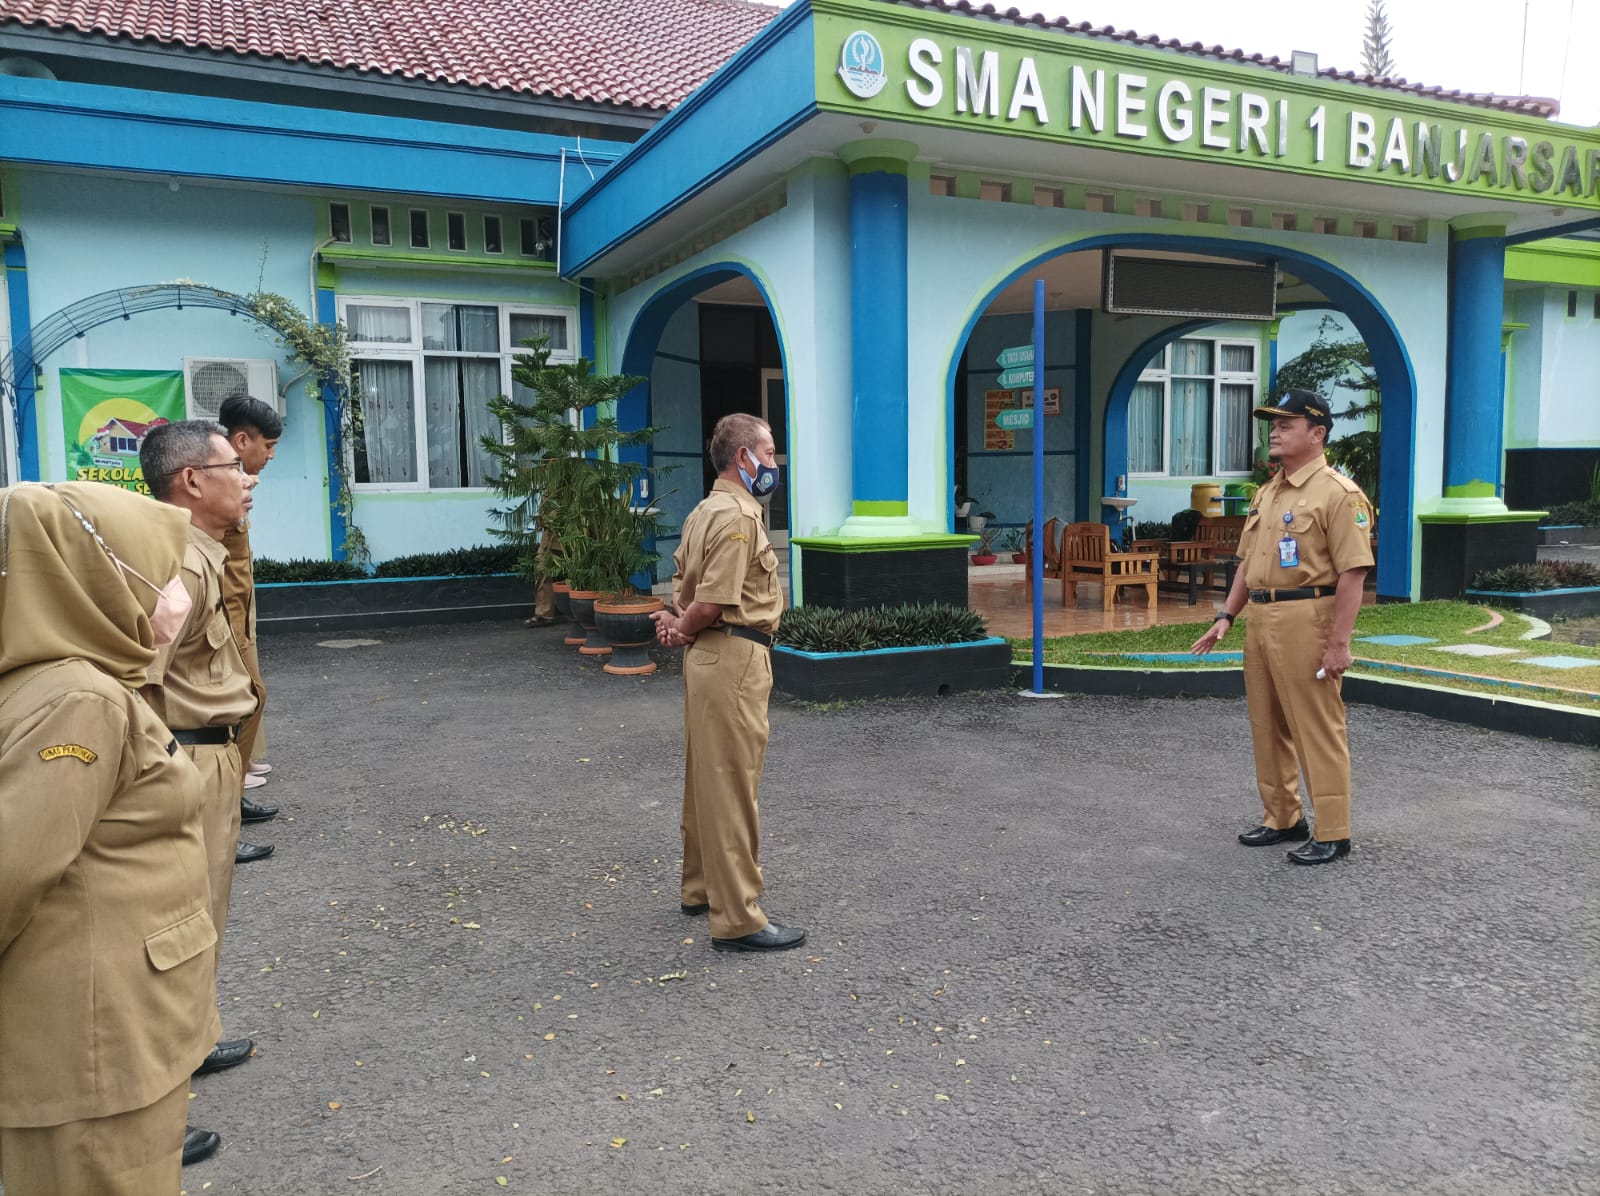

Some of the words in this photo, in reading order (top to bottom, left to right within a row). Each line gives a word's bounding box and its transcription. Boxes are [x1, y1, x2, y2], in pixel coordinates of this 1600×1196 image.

[906, 38, 1048, 124] SMA
[1069, 65, 1288, 158] NEGERI
[1308, 104, 1325, 162] 1
[1002, 413, 1029, 426] MESJID
